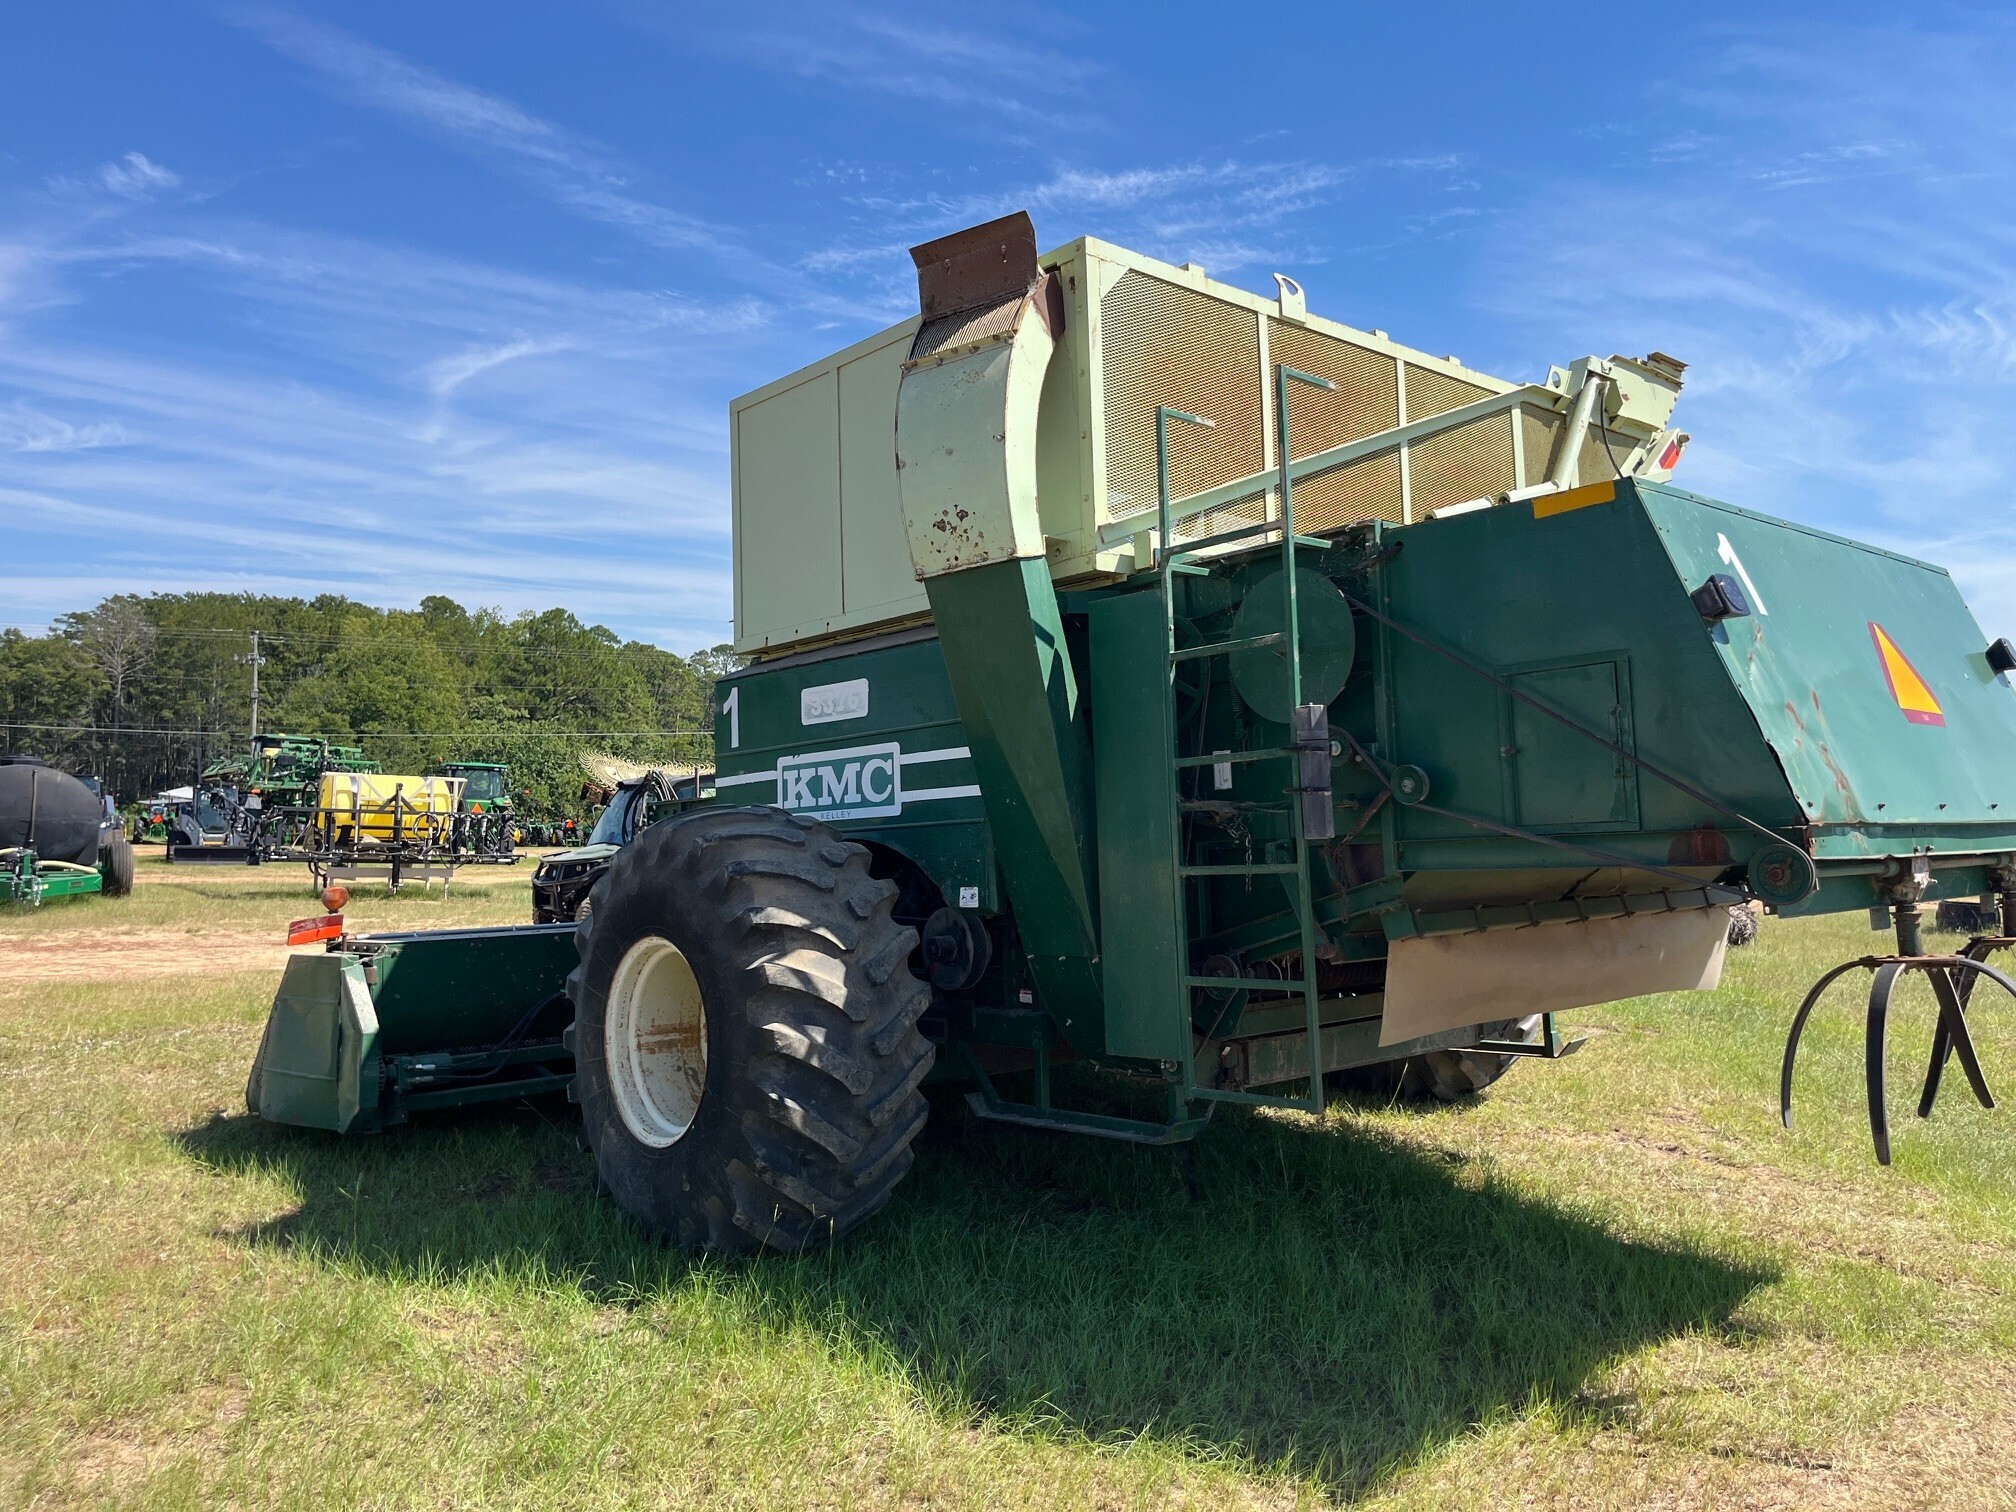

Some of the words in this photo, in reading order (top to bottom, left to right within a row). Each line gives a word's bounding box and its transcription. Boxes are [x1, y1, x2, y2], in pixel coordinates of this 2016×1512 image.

[1716, 532, 1769, 616] 1
[722, 686, 740, 749] 1
[783, 758, 893, 809] KMC
[820, 810, 852, 820] KELLEY
